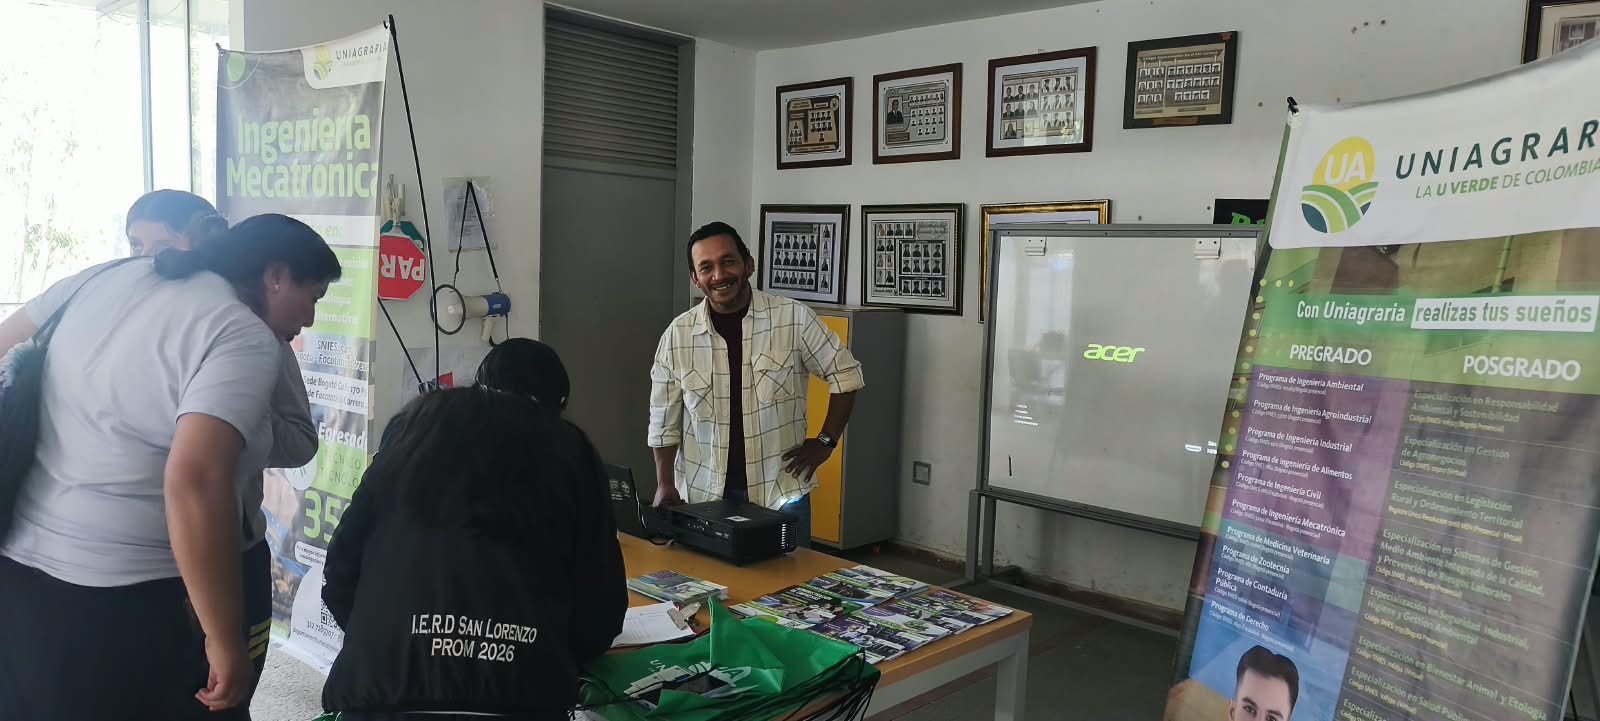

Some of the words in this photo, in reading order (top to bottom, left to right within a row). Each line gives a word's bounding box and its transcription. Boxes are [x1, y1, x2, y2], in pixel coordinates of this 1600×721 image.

[1395, 119, 1600, 179] UNIAGRAR
[1324, 153, 1366, 184] UA
[1416, 185, 1432, 199] LA
[1436, 184, 1448, 196] U
[1451, 176, 1499, 194] VERDE
[1502, 173, 1521, 188] DE
[381, 254, 425, 281] PAR
[1297, 301, 1318, 319] Con
[1323, 302, 1406, 324] Uniagraria
[1416, 301, 1477, 322] realizas
[1482, 302, 1509, 321] tus
[1515, 299, 1592, 323] sueños
[1084, 344, 1146, 363] acer
[1290, 344, 1373, 366] PREGRADO
[1463, 354, 1581, 381] POSGRADO
[1259, 373, 1287, 383] Programa
[1297, 377, 1325, 387] Ingeniería
[1326, 381, 1364, 392] Ambiental
[1254, 400, 1282, 411] Programa
[1292, 405, 1321, 416] Ingeniería
[1322, 410, 1372, 424] Agroindustrial
[1248, 426, 1276, 438] Programa
[1276, 432, 1285, 440] de
[1286, 433, 1319, 446] Ingeniería
[1320, 440, 1352, 452] Industrial
[1401, 448, 1411, 456] de
[1242, 450, 1271, 462] Programa
[1312, 464, 1320, 473] de
[1320, 467, 1352, 480] Alimentos
[1238, 473, 1266, 485] Programa
[1275, 482, 1305, 496] Ingeniería
[1306, 489, 1322, 499] Civil
[304, 490, 351, 544] 35
[1232, 499, 1260, 513] Programa
[1261, 506, 1268, 515] de
[1269, 509, 1301, 525] Ingeniería
[1302, 518, 1346, 537] Mecatrónica
[1392, 493, 1412, 504] Rural
[1413, 499, 1419, 507] y
[1480, 511, 1523, 528] Territorial
[1227, 526, 1255, 540] Programa
[1263, 537, 1291, 552] Medicina
[1293, 547, 1330, 565] Veterinaria
[1442, 546, 1452, 554] en
[1491, 557, 1502, 568] de
[1223, 545, 1250, 560] Programa
[1250, 554, 1258, 563] de
[1259, 557, 1290, 575] Zootecnia
[1380, 542, 1405, 555] Medio
[1406, 549, 1443, 567] Ambiente
[1487, 572, 1498, 582] de
[1499, 576, 1507, 584] la
[1216, 577, 1237, 592] Pública
[1218, 567, 1244, 584] Programa
[1245, 578, 1252, 586] de
[1253, 581, 1288, 600] Contaduría
[1428, 568, 1438, 578] de
[1471, 581, 1512, 602] Laborales
[411, 614, 455, 634] I.E.R.D
[1211, 601, 1238, 617] Programa
[1238, 612, 1246, 621] de
[1246, 616, 1269, 631] Derecho
[1428, 607, 1439, 616] en
[1439, 609, 1481, 631] Seguridad
[1434, 623, 1479, 646] Ambiental
[431, 638, 475, 658] PROM
[478, 642, 515, 662] 2026
[1415, 660, 1425, 669] en
[1426, 664, 1465, 685] Bienestar
[1467, 680, 1498, 699] Animal
[1500, 695, 1507, 705] y
[1408, 693, 1418, 702] en
